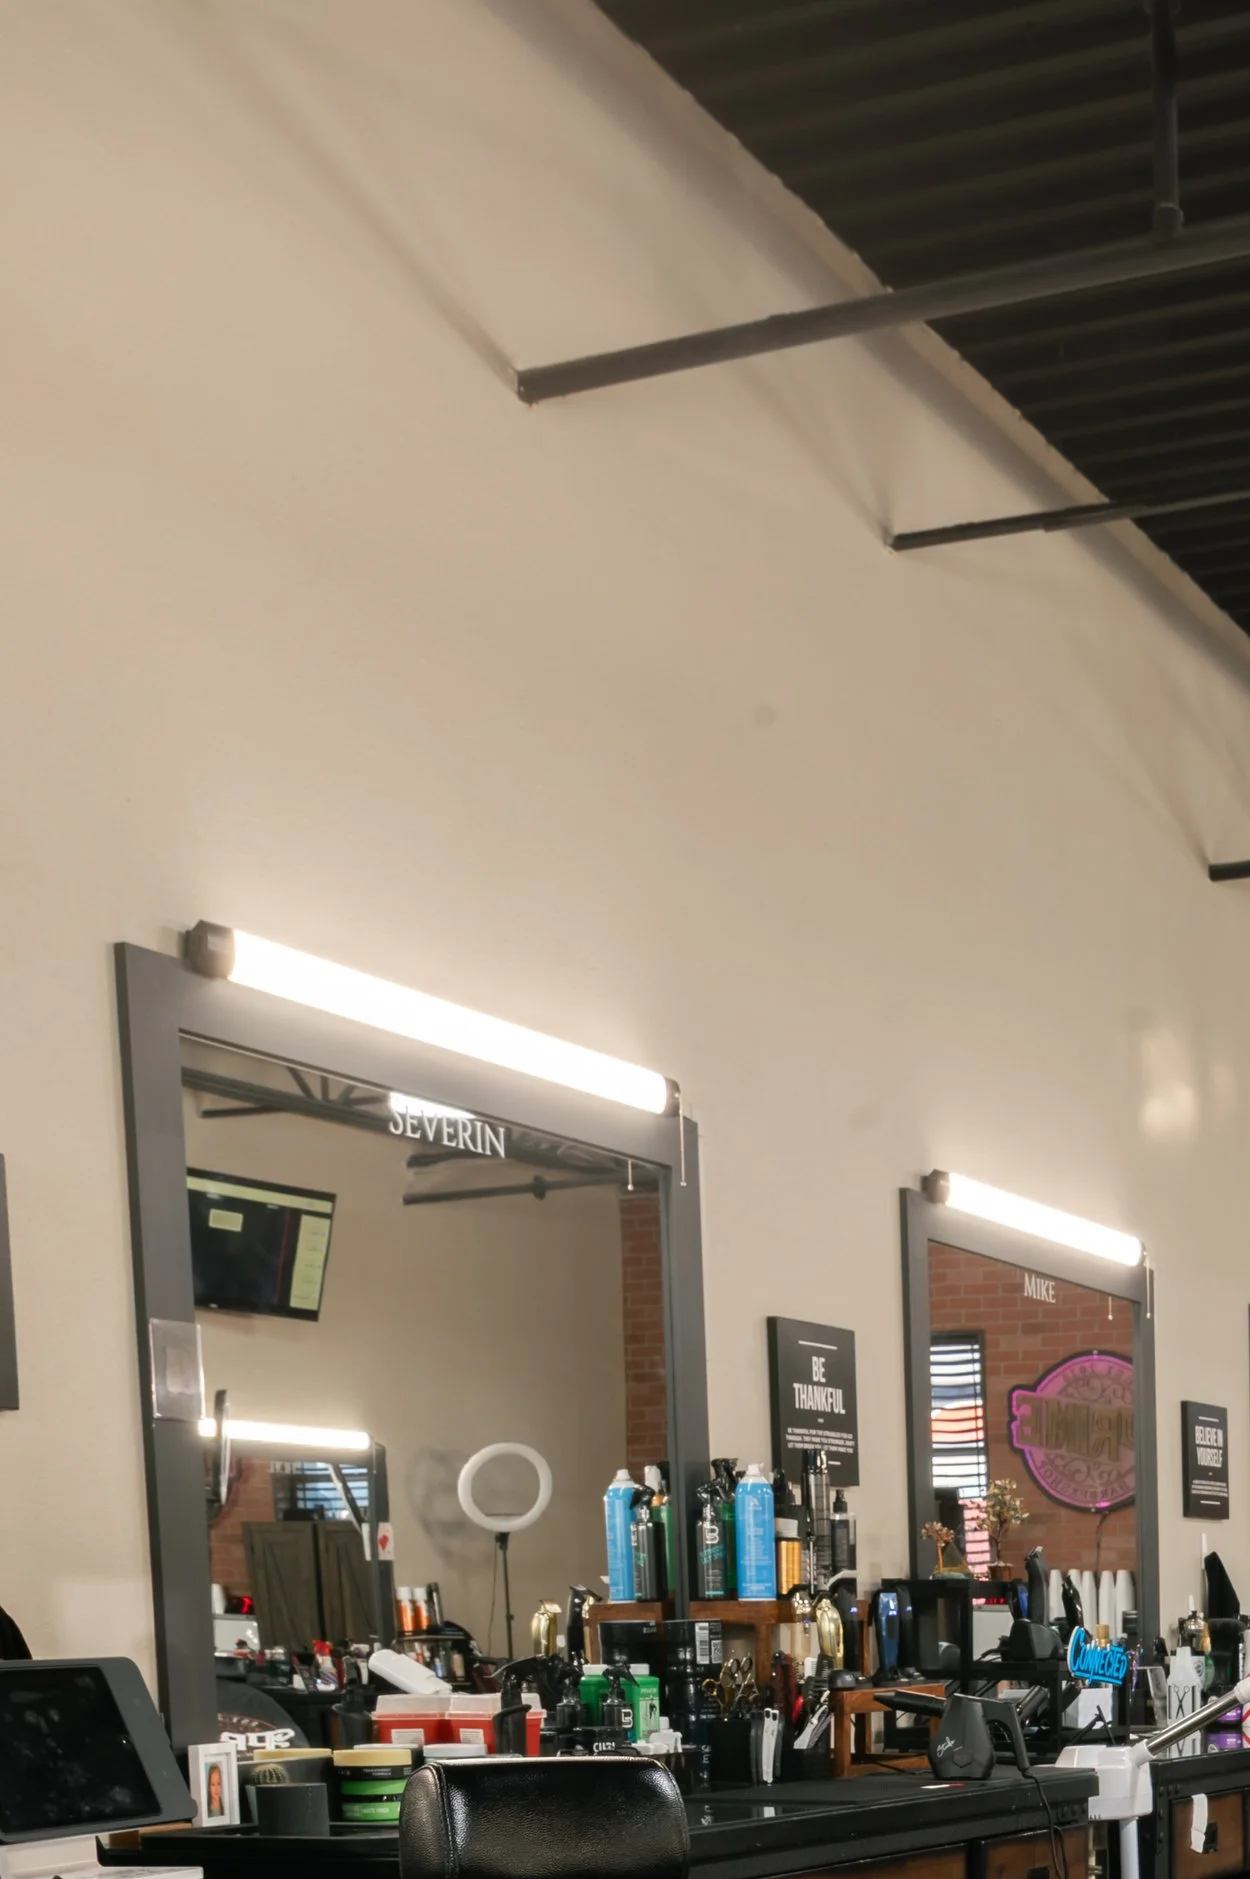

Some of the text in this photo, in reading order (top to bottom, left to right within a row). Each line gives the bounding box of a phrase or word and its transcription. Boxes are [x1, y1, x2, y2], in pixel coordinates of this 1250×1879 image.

[389, 1104, 505, 1159] SEVERIN
[1024, 1272, 1056, 1304] MIKE
[811, 1356, 826, 1382] BE
[793, 1382, 846, 1415] THANKFUL
[1067, 1626, 1128, 1684] CONNECTED
